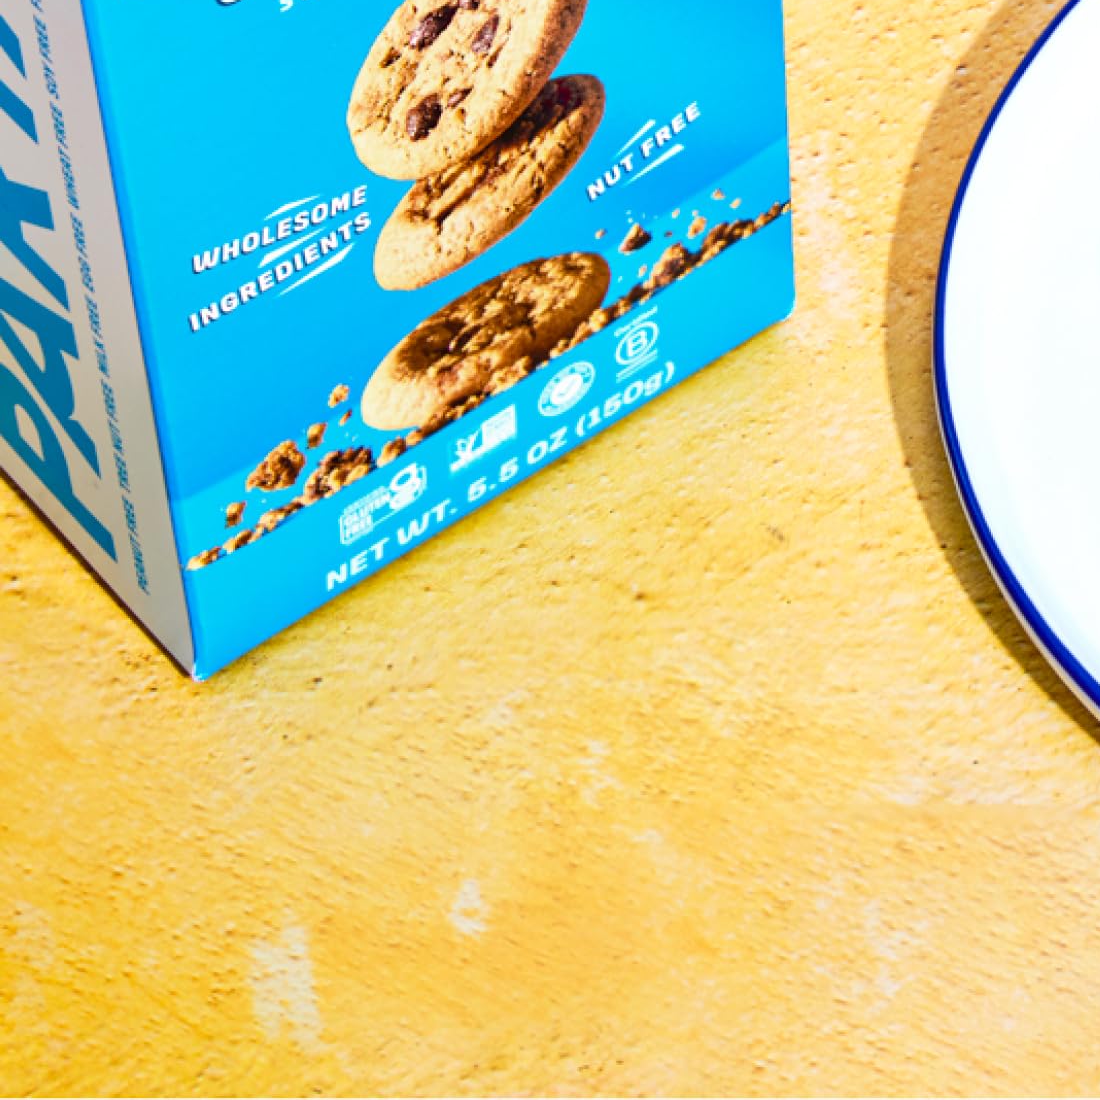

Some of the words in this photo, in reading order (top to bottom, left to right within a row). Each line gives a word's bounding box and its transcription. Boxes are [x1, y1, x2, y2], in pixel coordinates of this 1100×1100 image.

[586, 153, 633, 201] NUT
[639, 101, 701, 158] FREE
[189, 211, 371, 332] INGREDIENTS
[192, 185, 367, 273] WHOLESOME
[327, 537, 389, 590] NET
[397, 499, 456, 545] WT.
[467, 457, 519, 501] 5.5
[527, 427, 568, 464] OZ
[576, 361, 675, 436] (150g)
